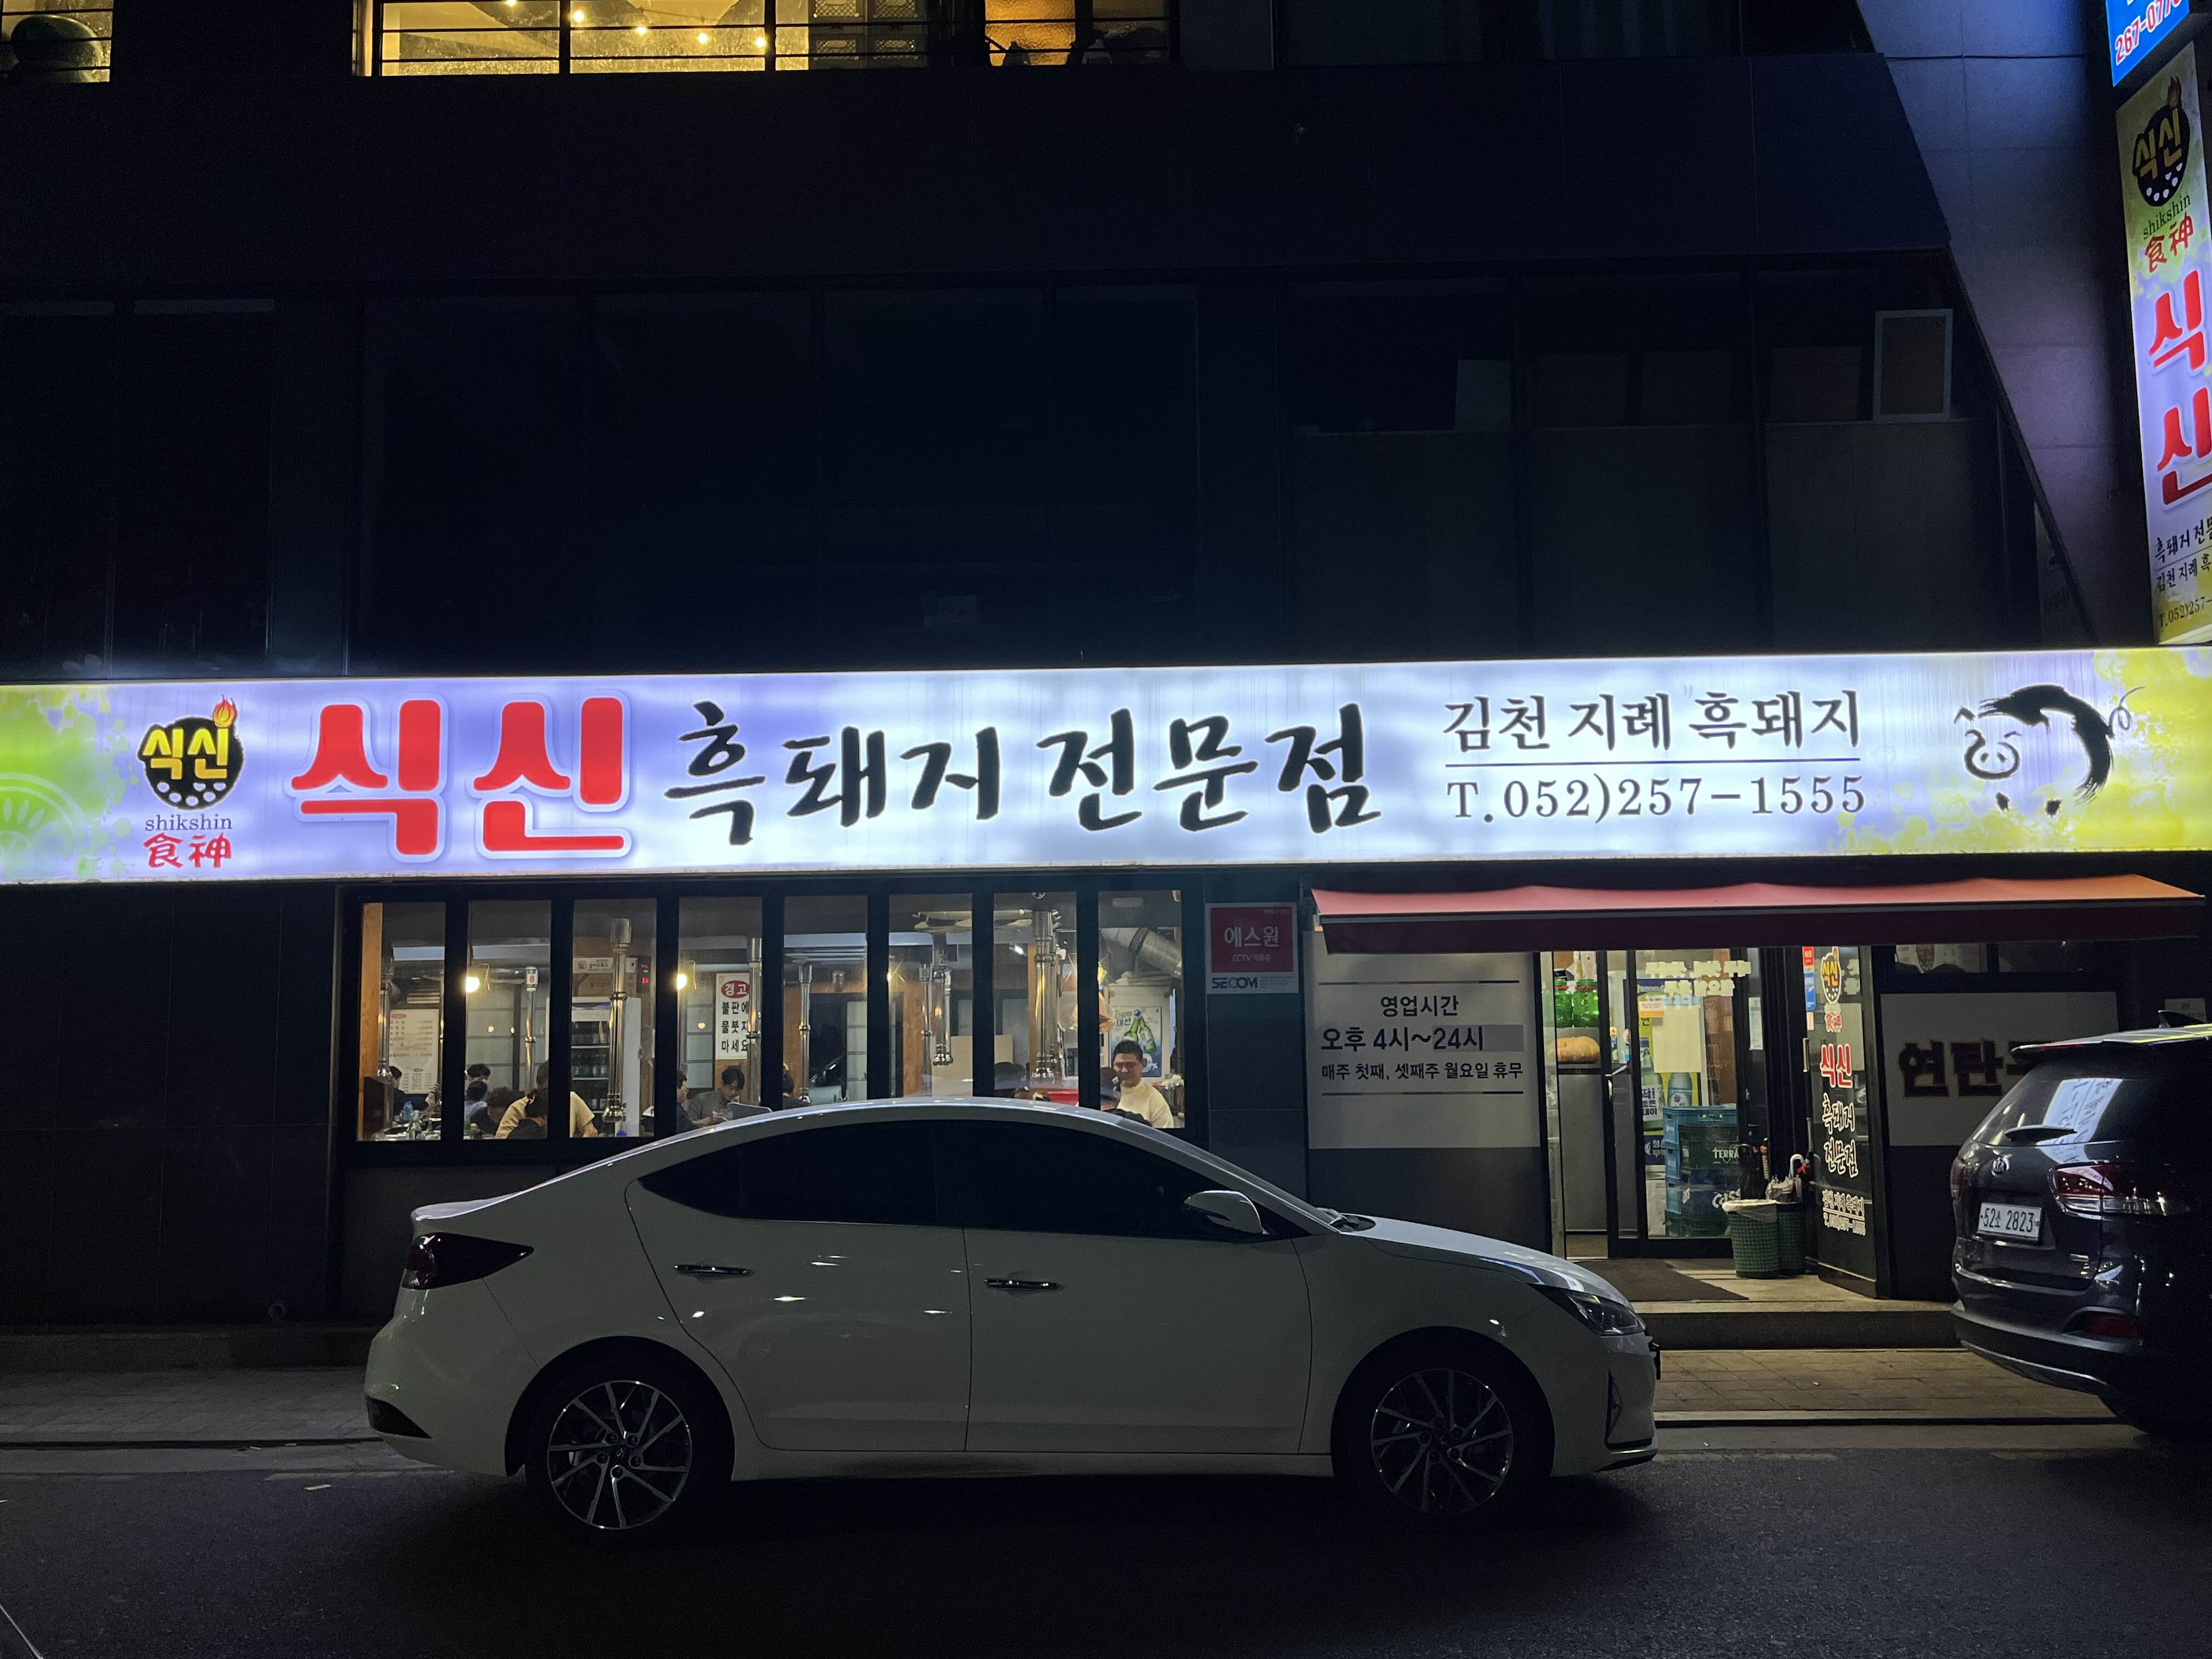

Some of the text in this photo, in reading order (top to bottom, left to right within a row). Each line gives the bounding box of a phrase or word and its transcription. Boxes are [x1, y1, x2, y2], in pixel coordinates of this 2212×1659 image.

[2136, 108, 2182, 180] 식신
[2143, 195, 2191, 240] shikshin
[2145, 212, 2194, 273] 食神
[2148, 269, 2212, 505] 식신
[2156, 568, 2176, 592] 김천
[2179, 558, 2198, 582] 지례
[1443, 690, 1859, 753] 김천 지례 흑돼지
[143, 728, 229, 780] 식신
[291, 697, 1382, 855] 식신 흑돼지 전문점
[1446, 772, 1865, 823] T.052)257-1555
[145, 814, 233, 831] shikshin
[143, 832, 232, 868] 食神
[1224, 926, 1279, 948] 에스원
[529, 975, 535, 983] 8
[724, 983, 748, 996] 경고
[1211, 977, 1259, 989] SECOM
[1822, 961, 1839, 987] 식신
[1380, 995, 1459, 1017] 영업시간
[721, 1039, 748, 1053] 마세요
[1321, 1027, 1367, 1052] 오후
[1322, 1062, 1523, 1081] 매주 첫째, 셋째주 월요일 휴무
[1820, 1044, 1853, 1088] 식신
[1822, 1092, 1855, 1135] 흑돼지
[1712, 1147, 1740, 1159] TERRA
[1824, 1137, 1859, 1178] 전문점
[1983, 1207, 2034, 1233] 52소 2823
